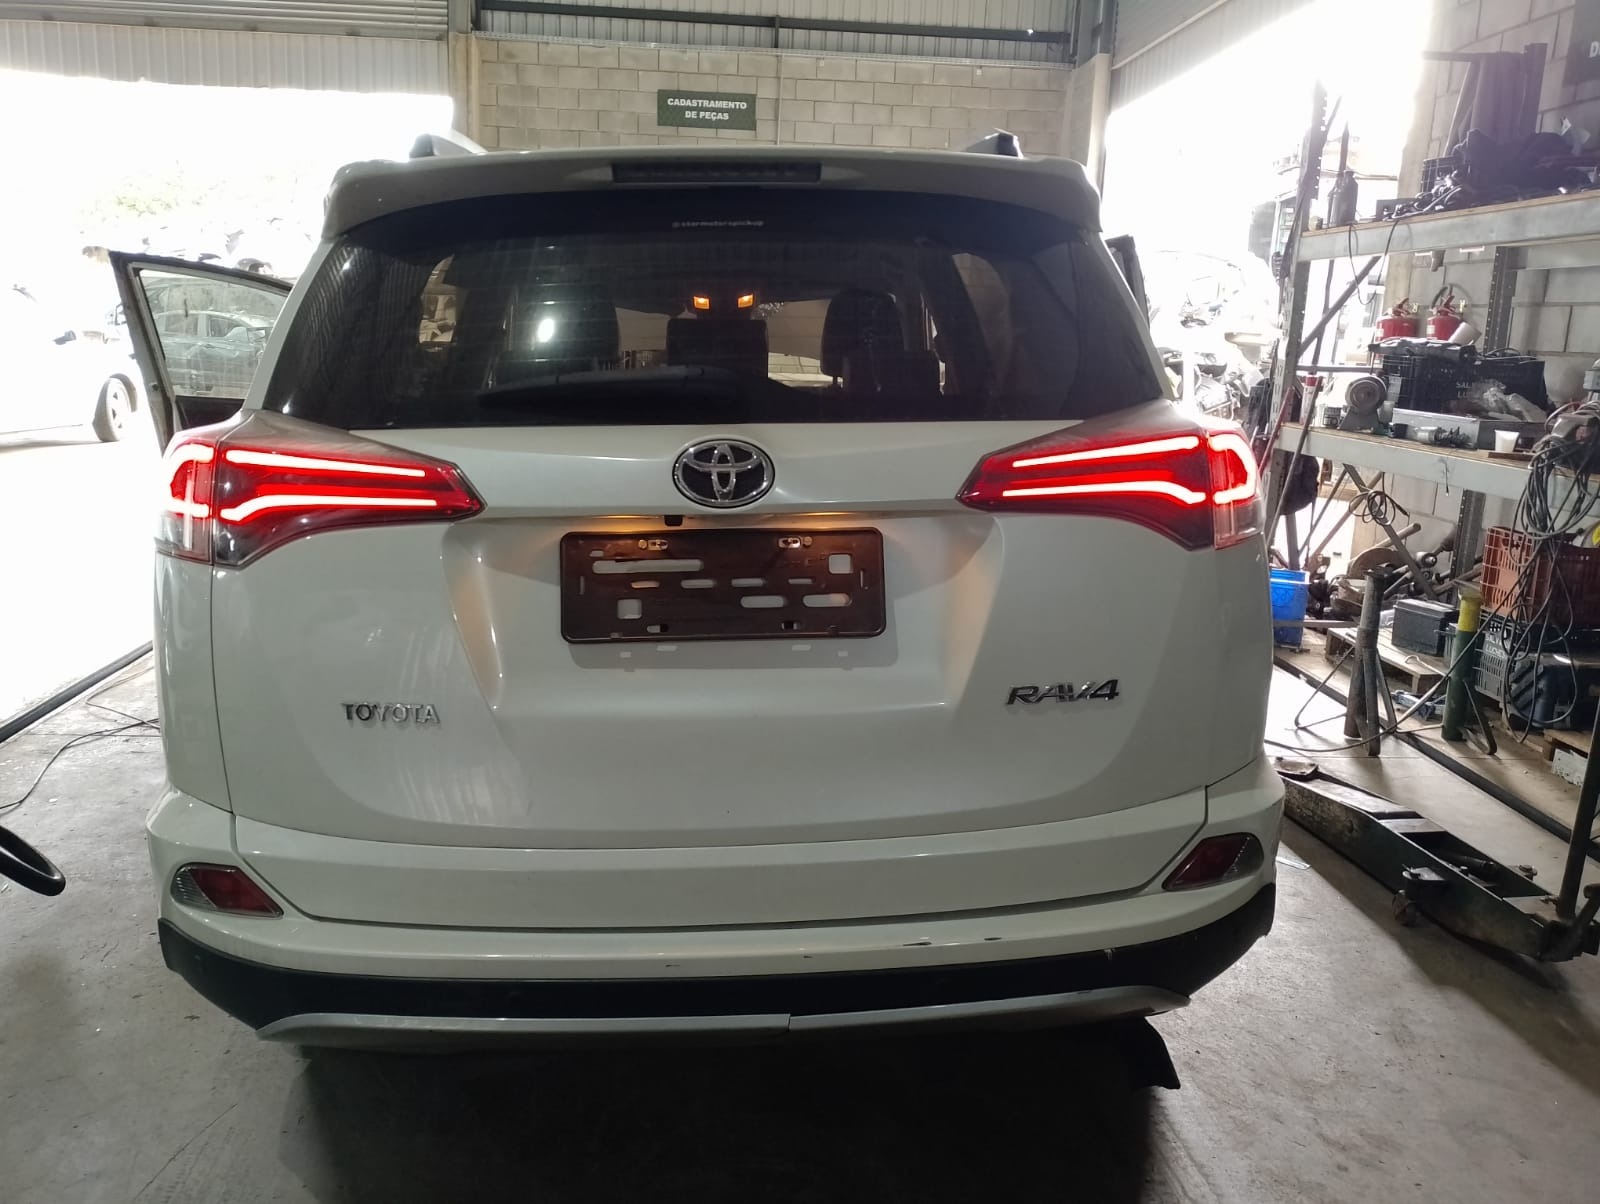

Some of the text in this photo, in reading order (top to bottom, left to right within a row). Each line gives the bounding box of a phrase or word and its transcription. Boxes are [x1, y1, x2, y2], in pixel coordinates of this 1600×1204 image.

[667, 98, 747, 110] CADASTRAMENTO
[685, 111, 729, 121] DE PEÇAS
[1006, 679, 1119, 705] RAV4
[341, 702, 441, 724] TOYOTA
